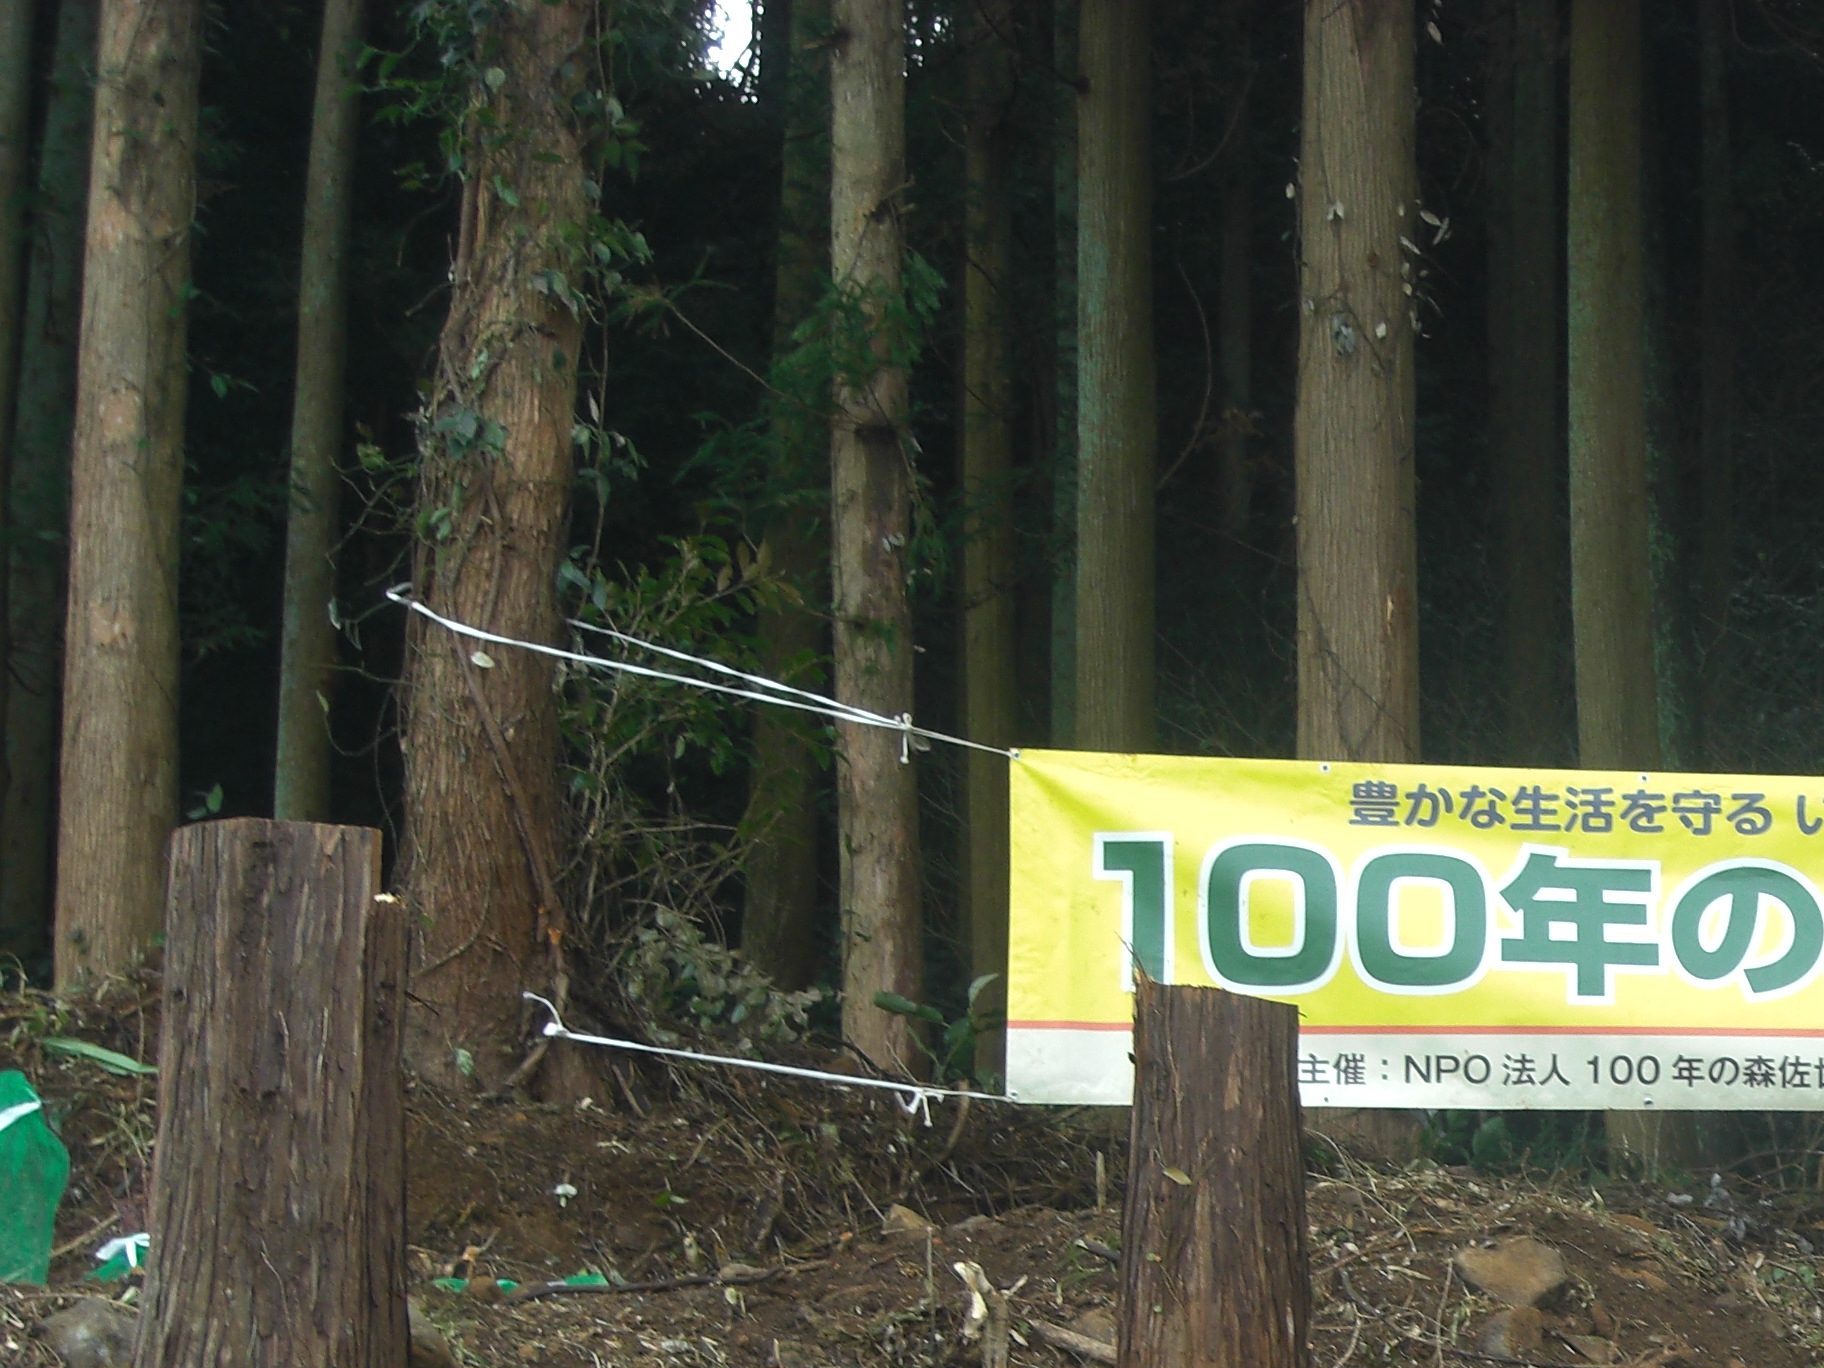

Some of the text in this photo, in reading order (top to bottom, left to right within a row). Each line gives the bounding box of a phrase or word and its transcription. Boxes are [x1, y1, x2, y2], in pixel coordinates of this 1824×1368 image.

[1349, 780, 1773, 836] 豊かな生活を守る
